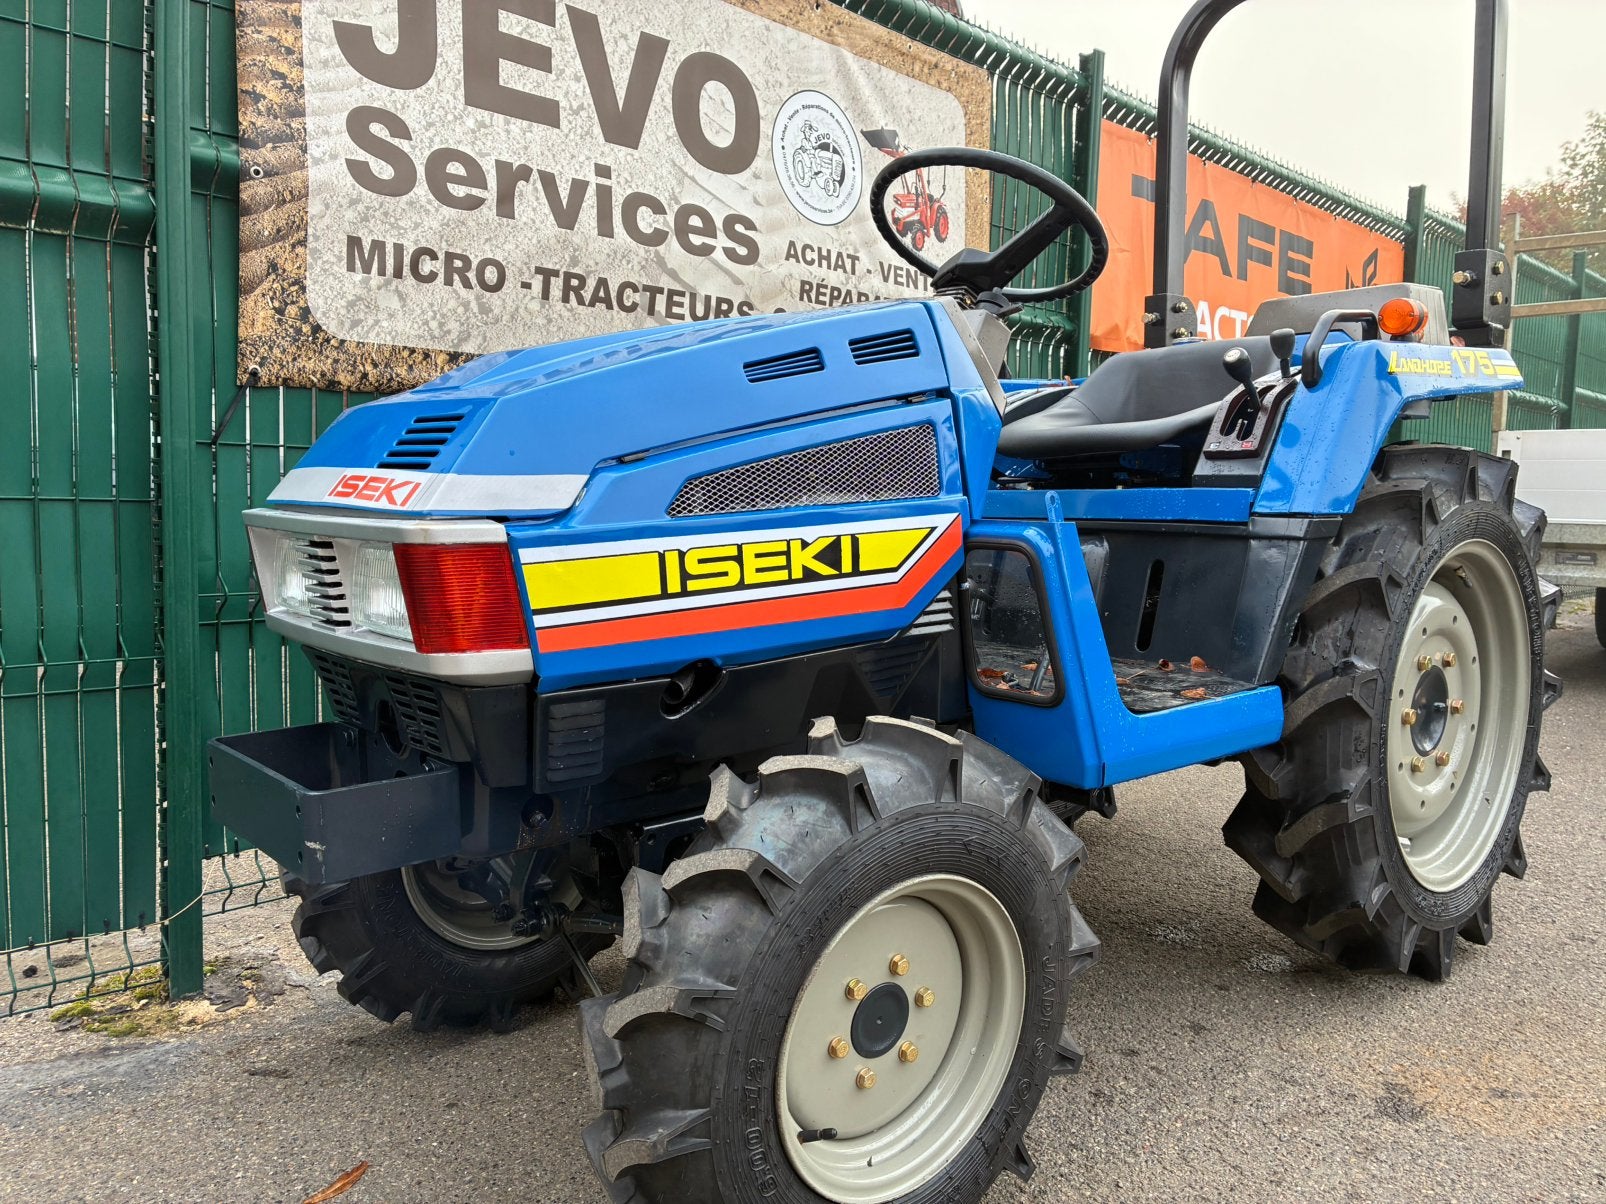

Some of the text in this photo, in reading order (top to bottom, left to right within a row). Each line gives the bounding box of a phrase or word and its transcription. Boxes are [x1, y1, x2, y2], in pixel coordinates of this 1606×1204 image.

[333, 0, 761, 176] JEVO
[814, 132, 831, 144] JEVO
[345, 105, 761, 266] Services
[346, 235, 507, 293] MICRO
[784, 240, 860, 274] ACHAT
[879, 261, 937, 293] VENT
[1451, 349, 1496, 375] 175
[327, 474, 422, 507] ISEKI
[664, 534, 854, 595] ISEKI
